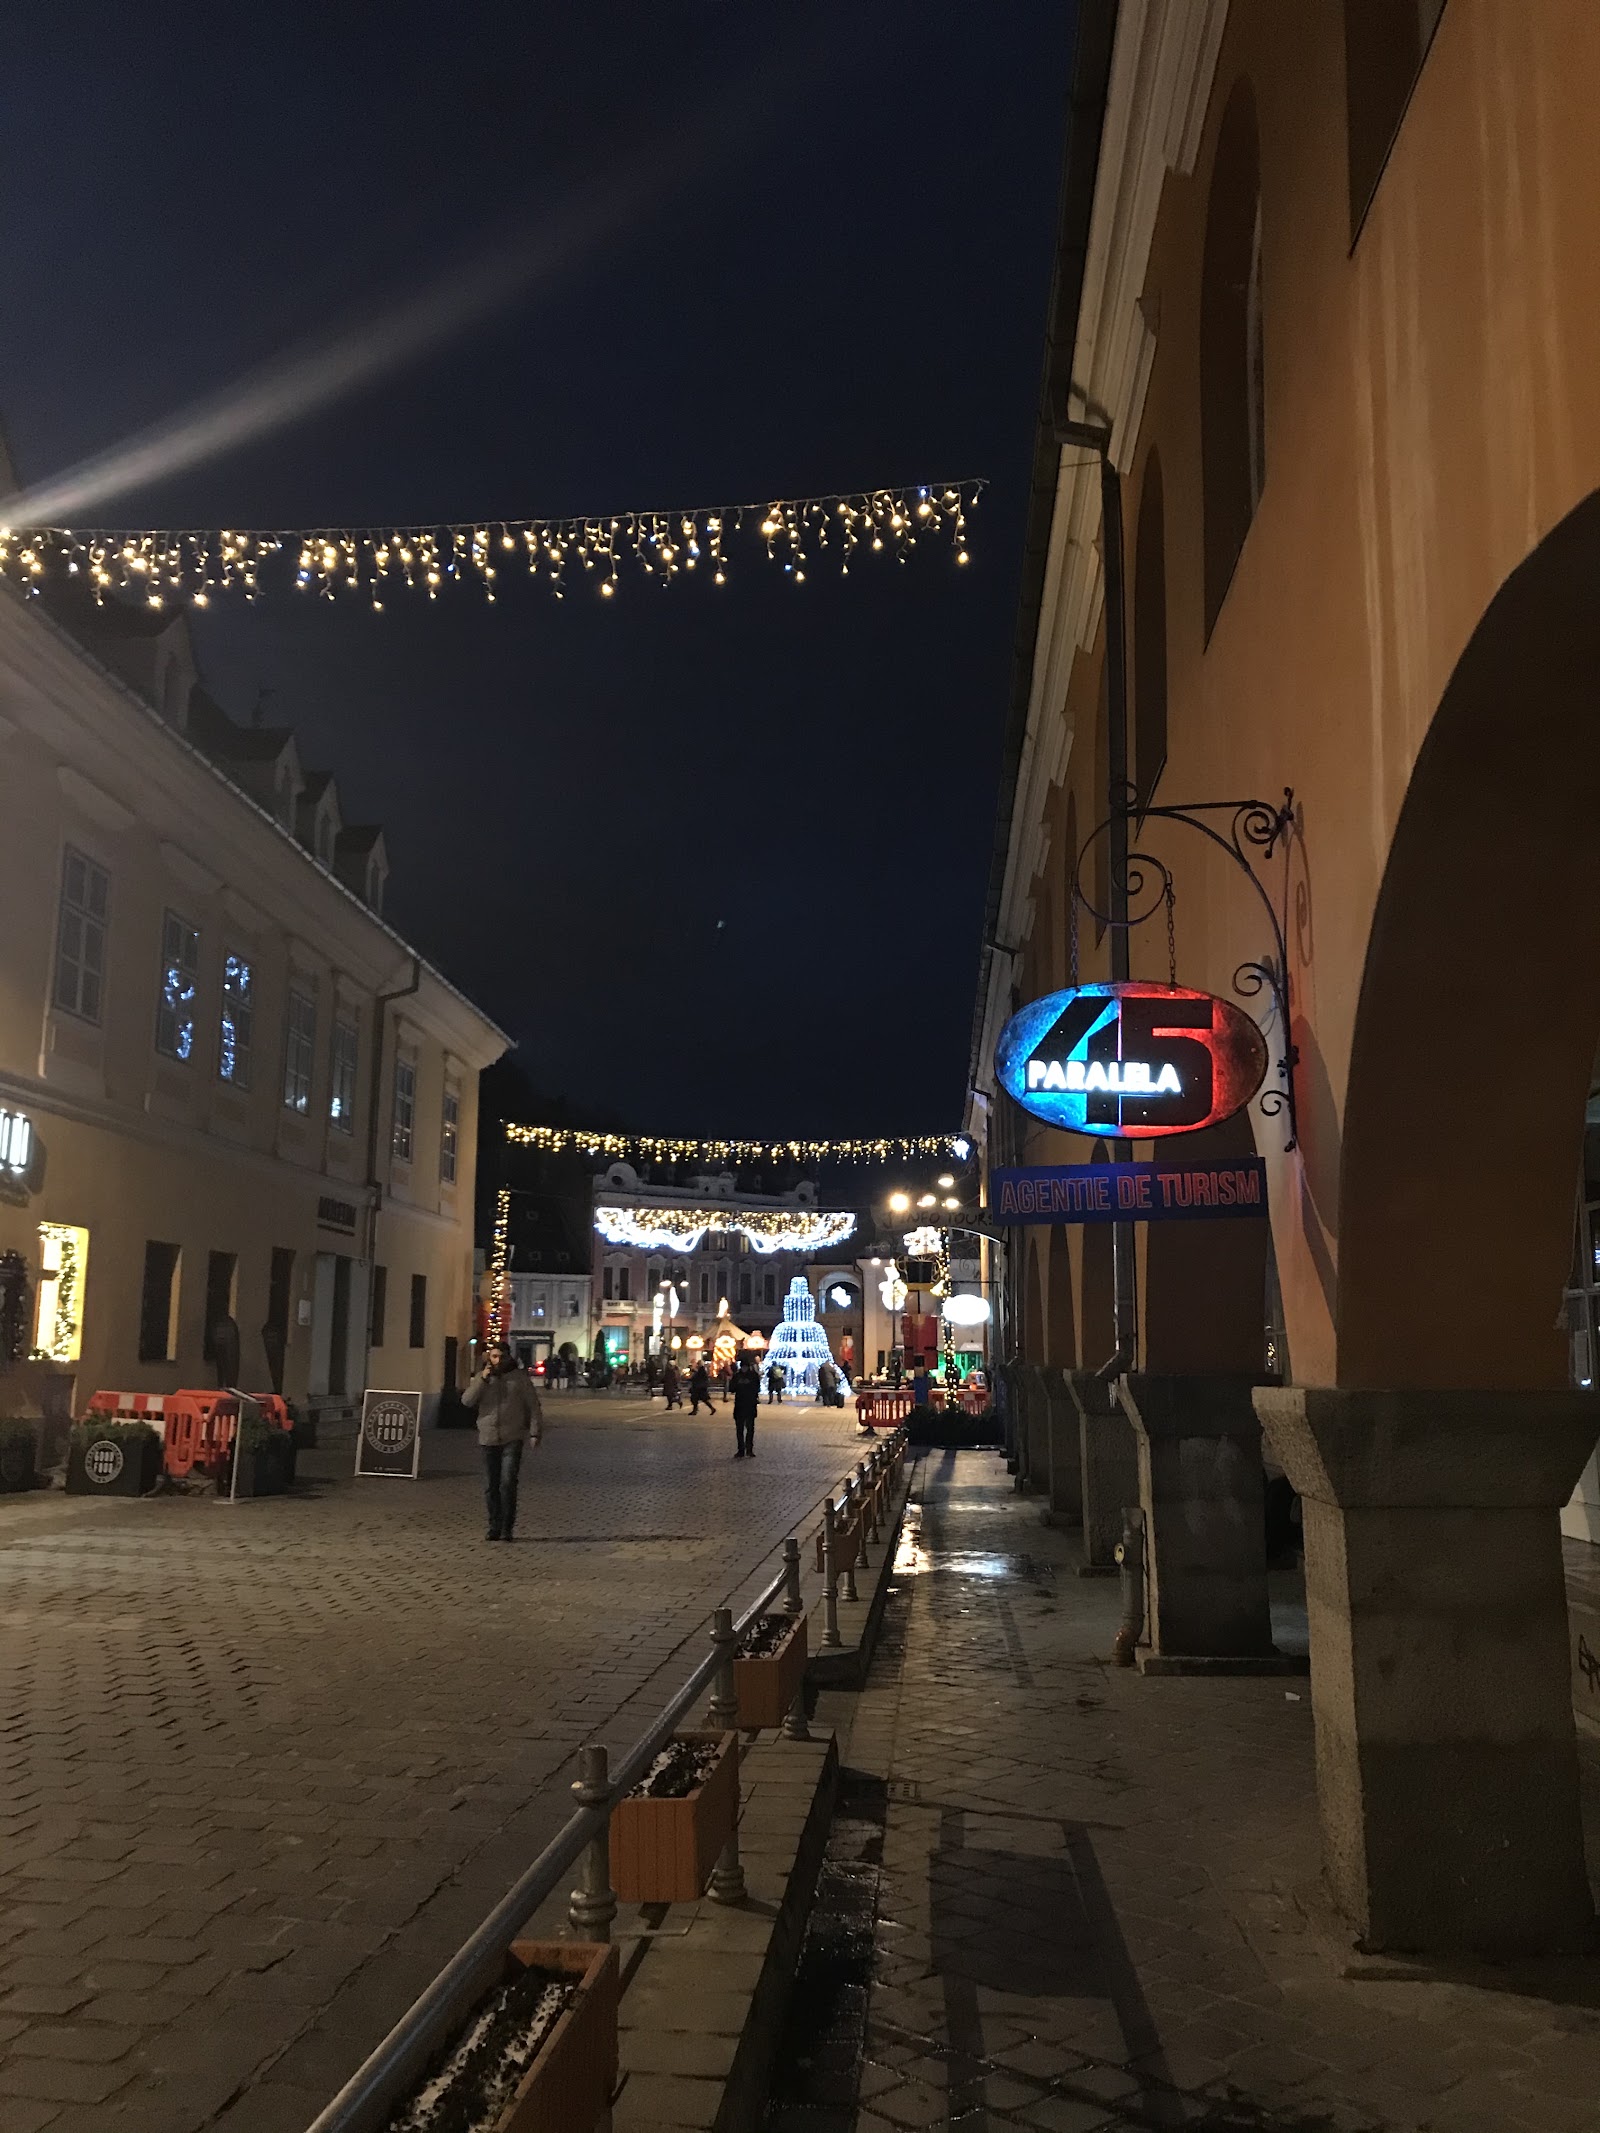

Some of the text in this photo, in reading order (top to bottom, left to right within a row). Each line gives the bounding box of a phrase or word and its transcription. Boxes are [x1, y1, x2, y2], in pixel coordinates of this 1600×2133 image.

[1025, 996, 1213, 1126] 45
[1027, 1059, 1182, 1093] PARALELA
[1000, 1169, 1261, 1215] AGENTIE DE TURISM
